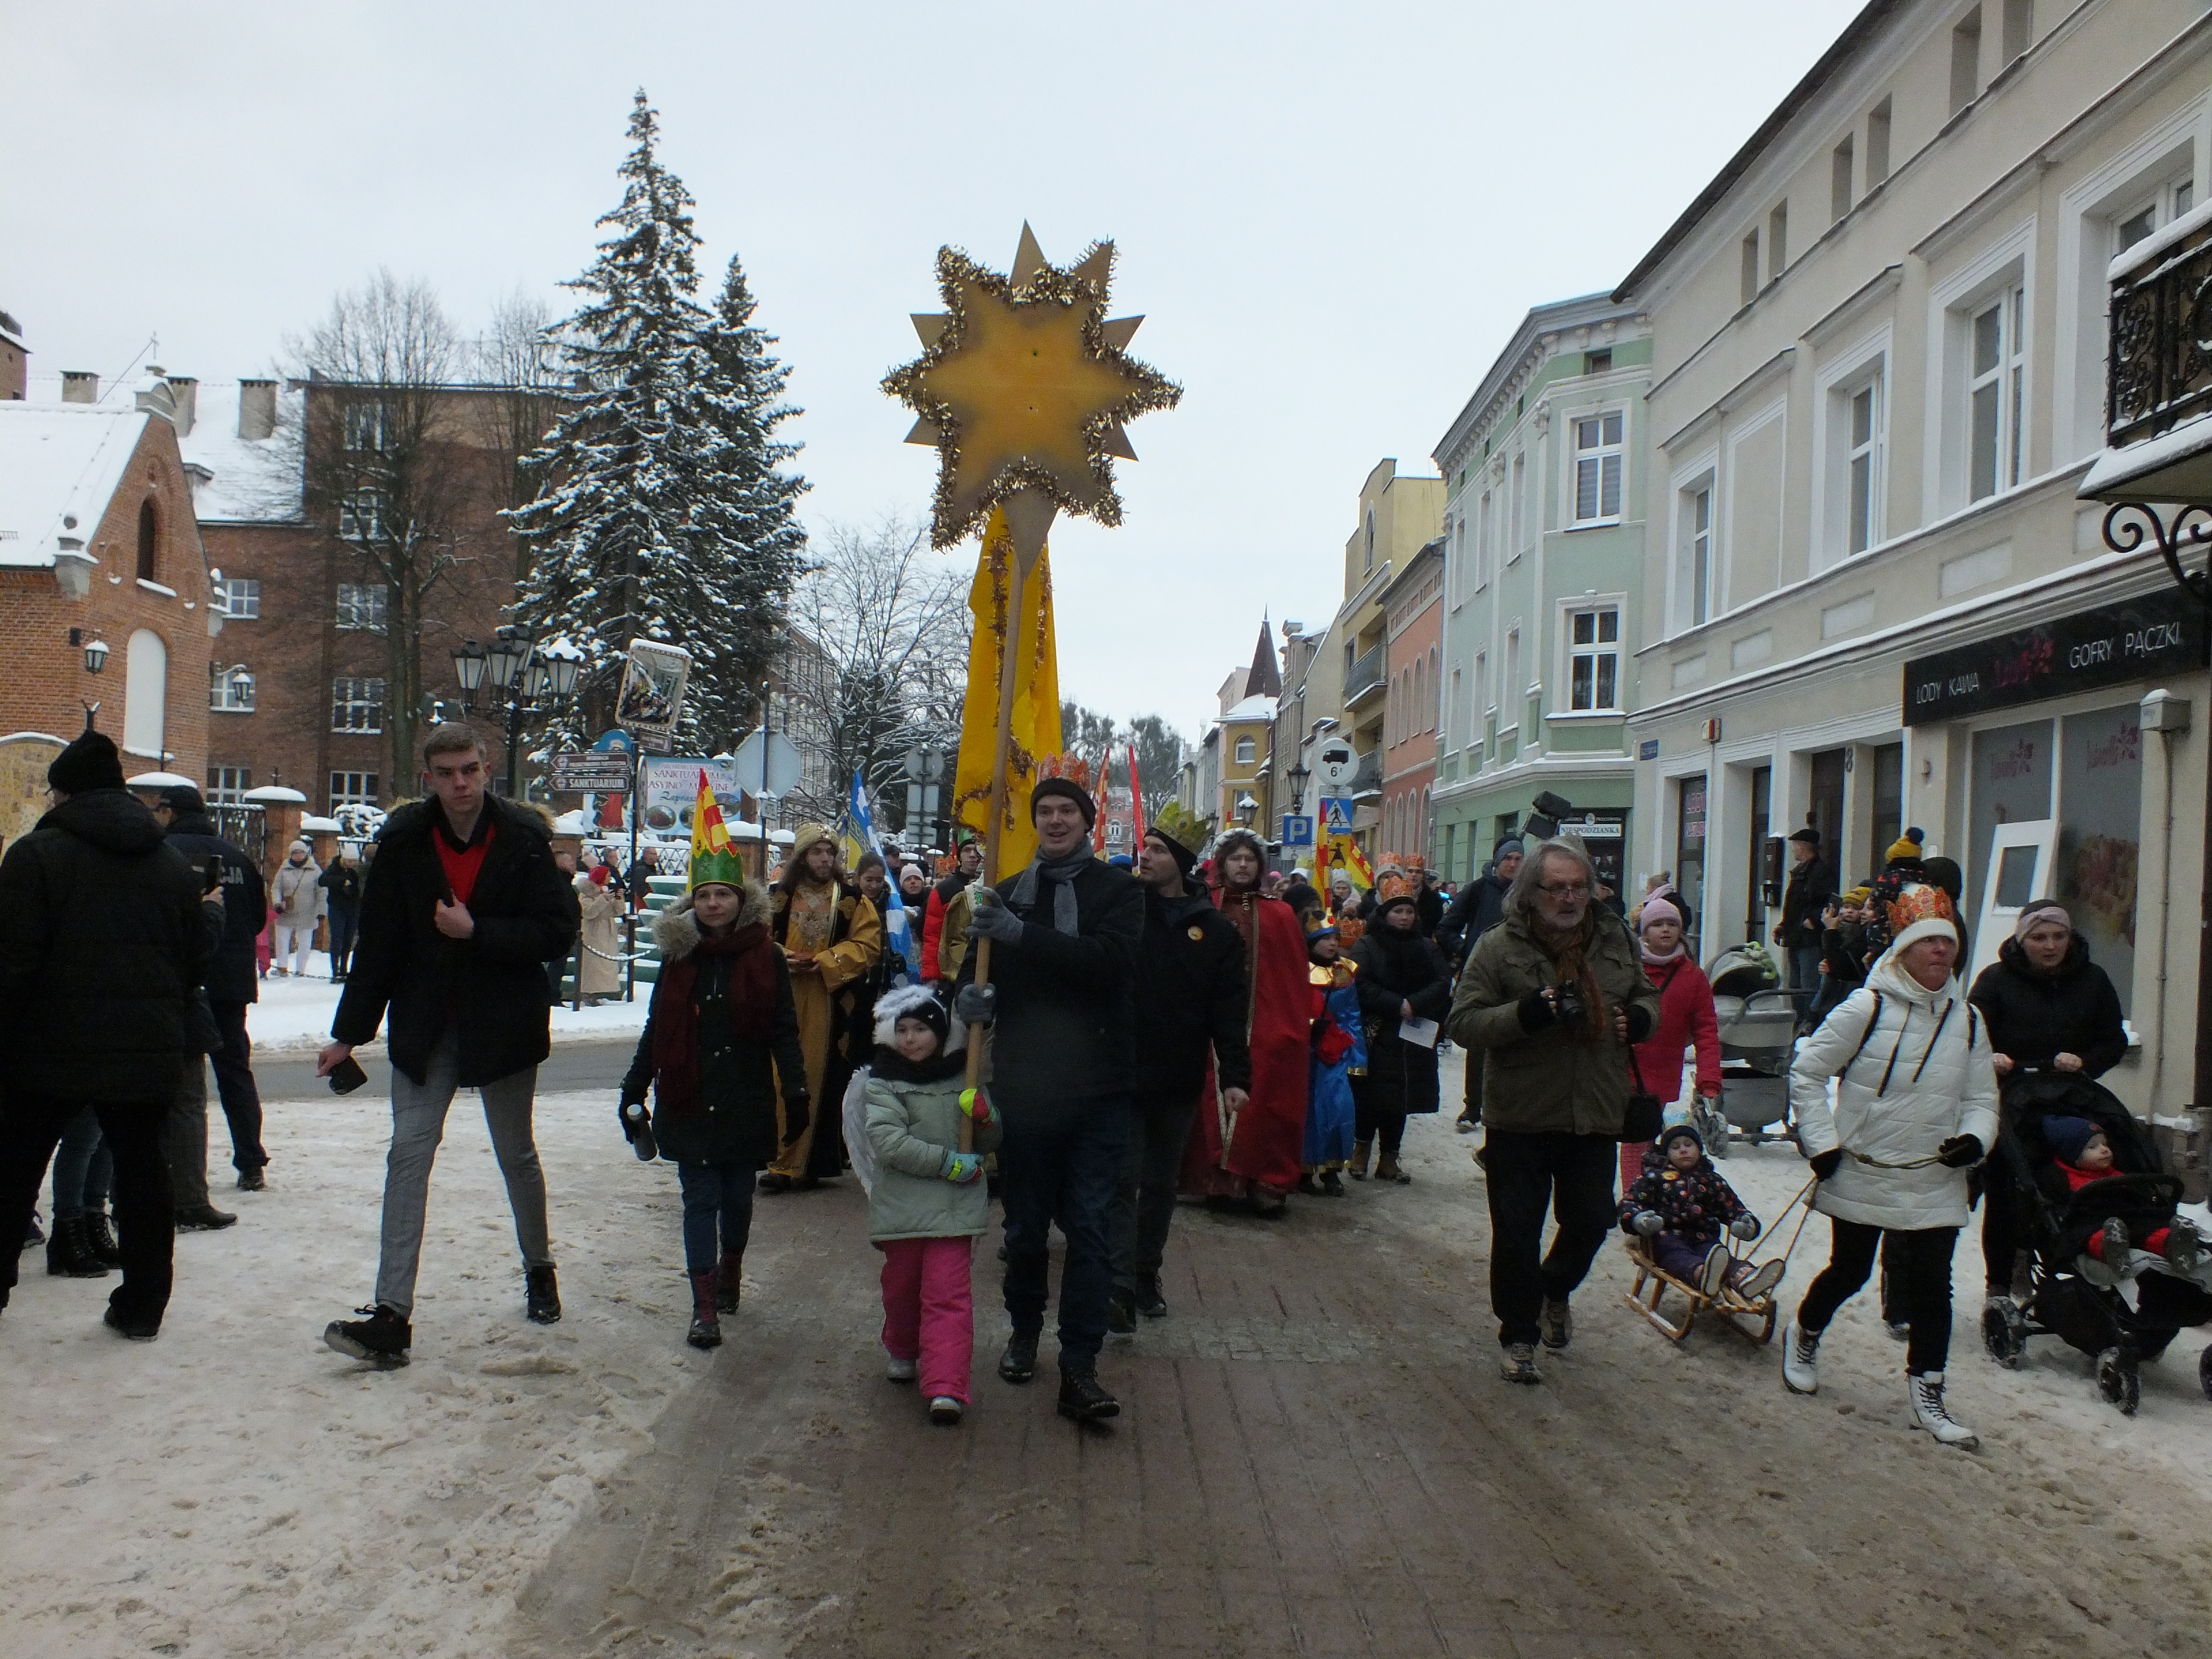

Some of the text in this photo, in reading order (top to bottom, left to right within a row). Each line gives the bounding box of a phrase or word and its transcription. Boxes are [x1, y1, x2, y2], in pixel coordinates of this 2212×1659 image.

[2070, 638, 2113, 668] GOFRY
[2125, 622, 2180, 658] PĄCZKI
[1916, 672, 1979, 704] LODY KAWA
[1331, 767, 1337, 777] 6
[1289, 819, 1307, 842] P
